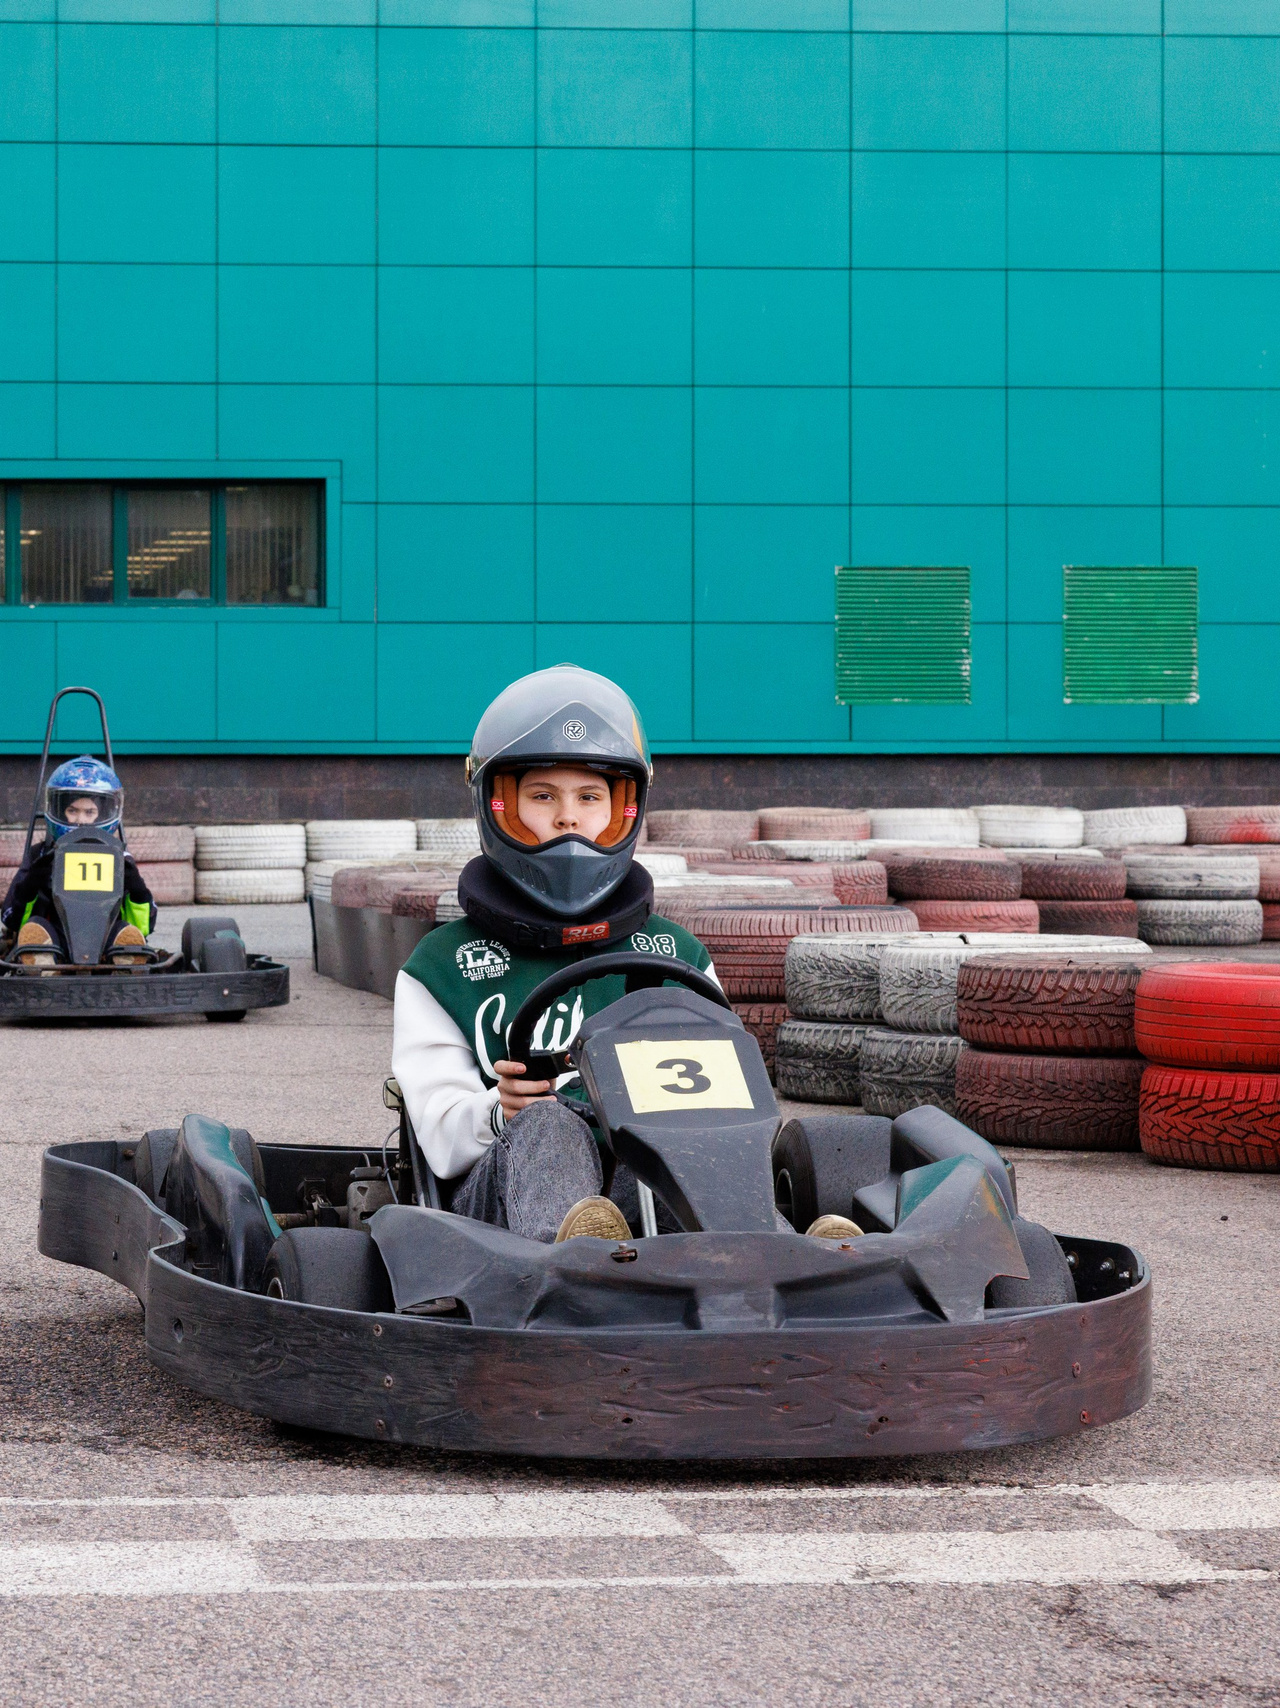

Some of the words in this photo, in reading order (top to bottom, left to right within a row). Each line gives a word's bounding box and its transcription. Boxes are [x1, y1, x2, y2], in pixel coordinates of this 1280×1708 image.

[77, 862, 102, 881] 11
[568, 925, 607, 938] RLG
[631, 932, 677, 958] 88
[463, 950, 503, 969] LA
[462, 963, 510, 978] CALIFORNIA
[470, 974, 486, 982] WEST
[487, 970, 505, 979] COAST
[655, 1058, 712, 1095] 3
